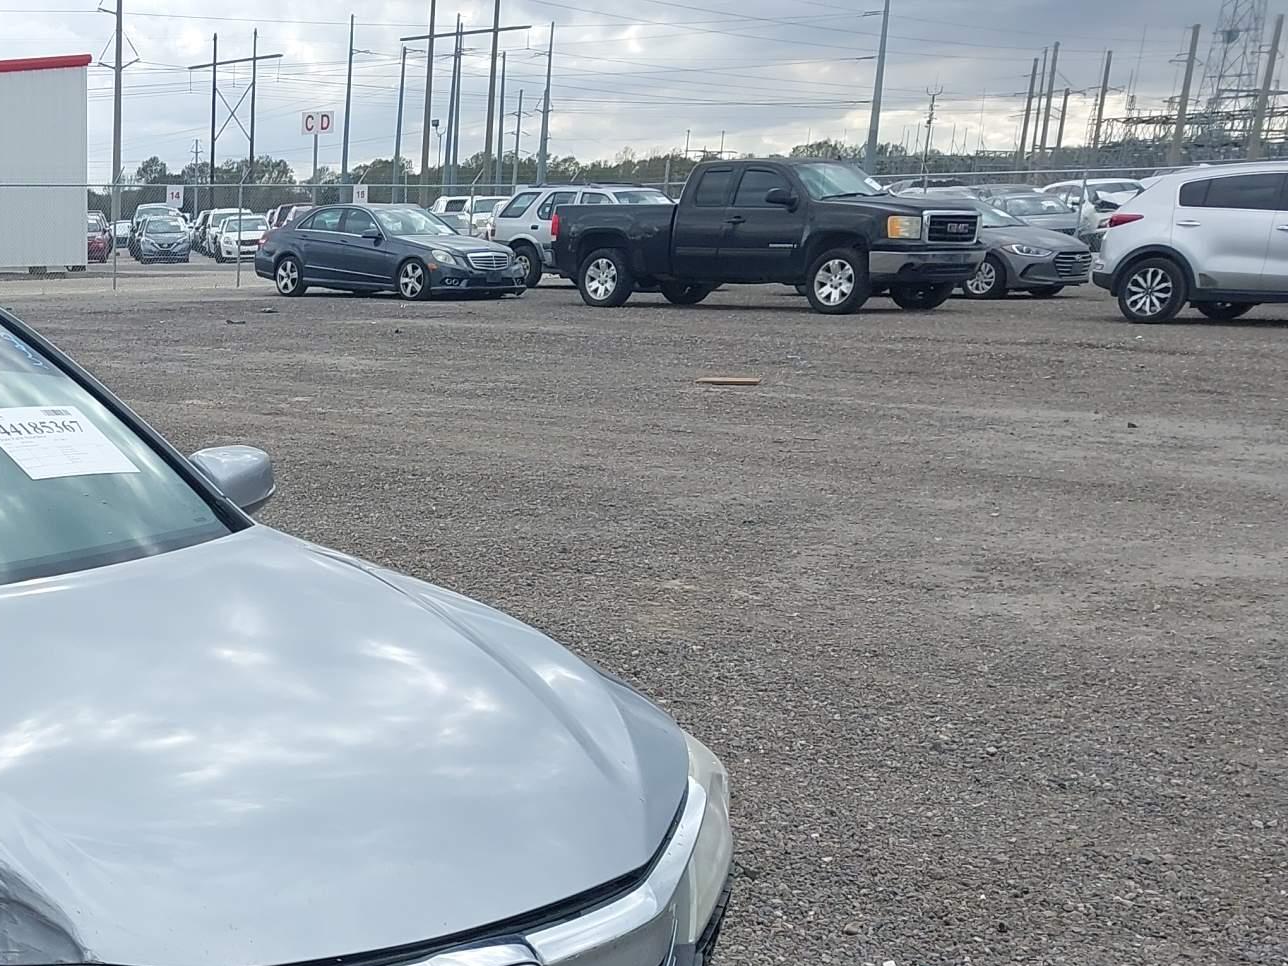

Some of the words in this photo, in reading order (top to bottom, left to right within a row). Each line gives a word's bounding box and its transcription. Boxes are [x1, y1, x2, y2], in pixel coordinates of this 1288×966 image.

[305, 114, 315, 132] C
[320, 114, 330, 131] D
[170, 191, 180, 200] 14
